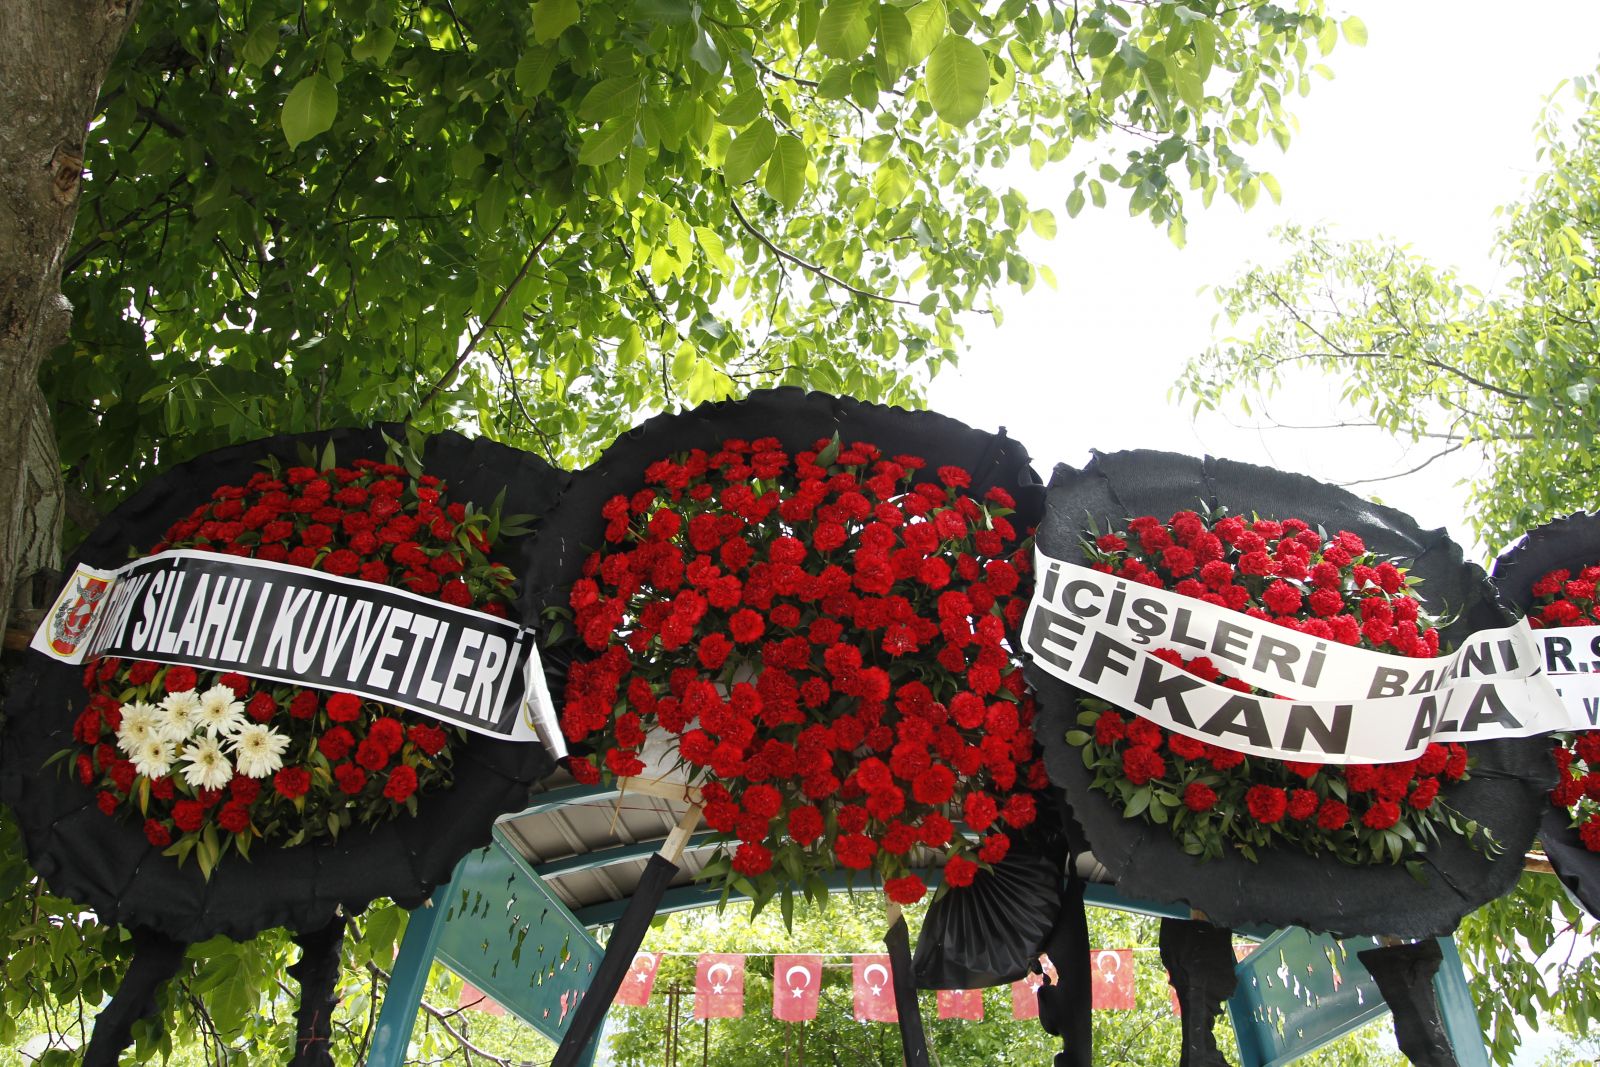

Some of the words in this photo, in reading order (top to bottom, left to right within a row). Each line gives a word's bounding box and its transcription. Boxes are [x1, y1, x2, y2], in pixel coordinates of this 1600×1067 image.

[132, 557, 273, 664] SİLAHLI
[262, 586, 526, 724] KUVVETLERİ
[1027, 604, 1353, 755] EFKAN
[1405, 683, 1524, 752] ALA
[1367, 639, 1520, 700] BANI
